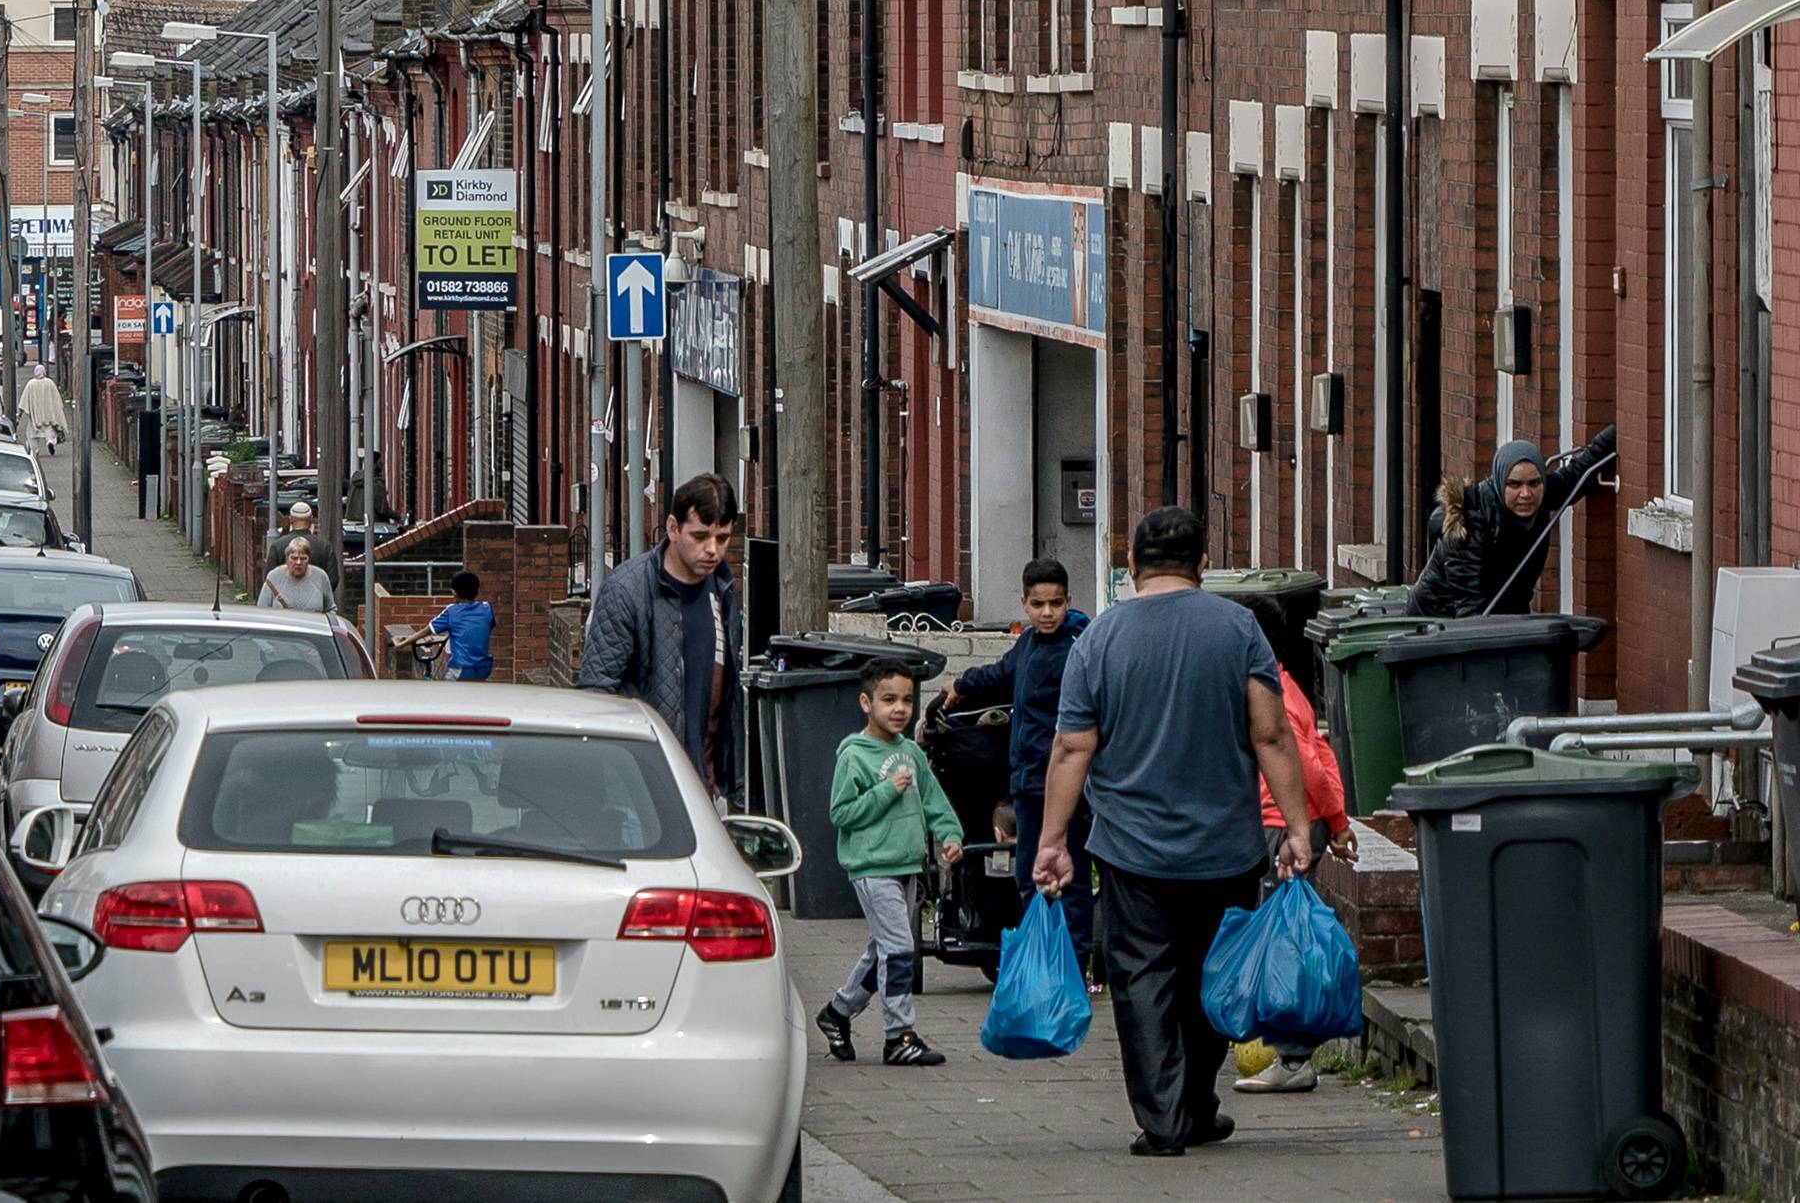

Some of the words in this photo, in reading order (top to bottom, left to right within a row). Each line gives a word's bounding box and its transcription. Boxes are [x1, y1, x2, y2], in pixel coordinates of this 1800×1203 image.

[456, 179, 493, 192] Kirkby
[456, 191, 508, 202] Diamond
[422, 216, 472, 226] GROUND
[474, 216, 512, 226] FLOOR
[434, 230, 472, 239] RETAIL
[475, 230, 501, 239] UNIT
[423, 245, 458, 266] TO
[467, 245, 512, 266] LET
[426, 280, 463, 292] 01582
[465, 281, 509, 293] 738866
[427, 295, 508, 303] www.kirkbydiamond.co.uk
[352, 947, 440, 983] ML10
[454, 948, 532, 985] OTU
[225, 986, 266, 1004] A3
[627, 998, 656, 1011] TDI
